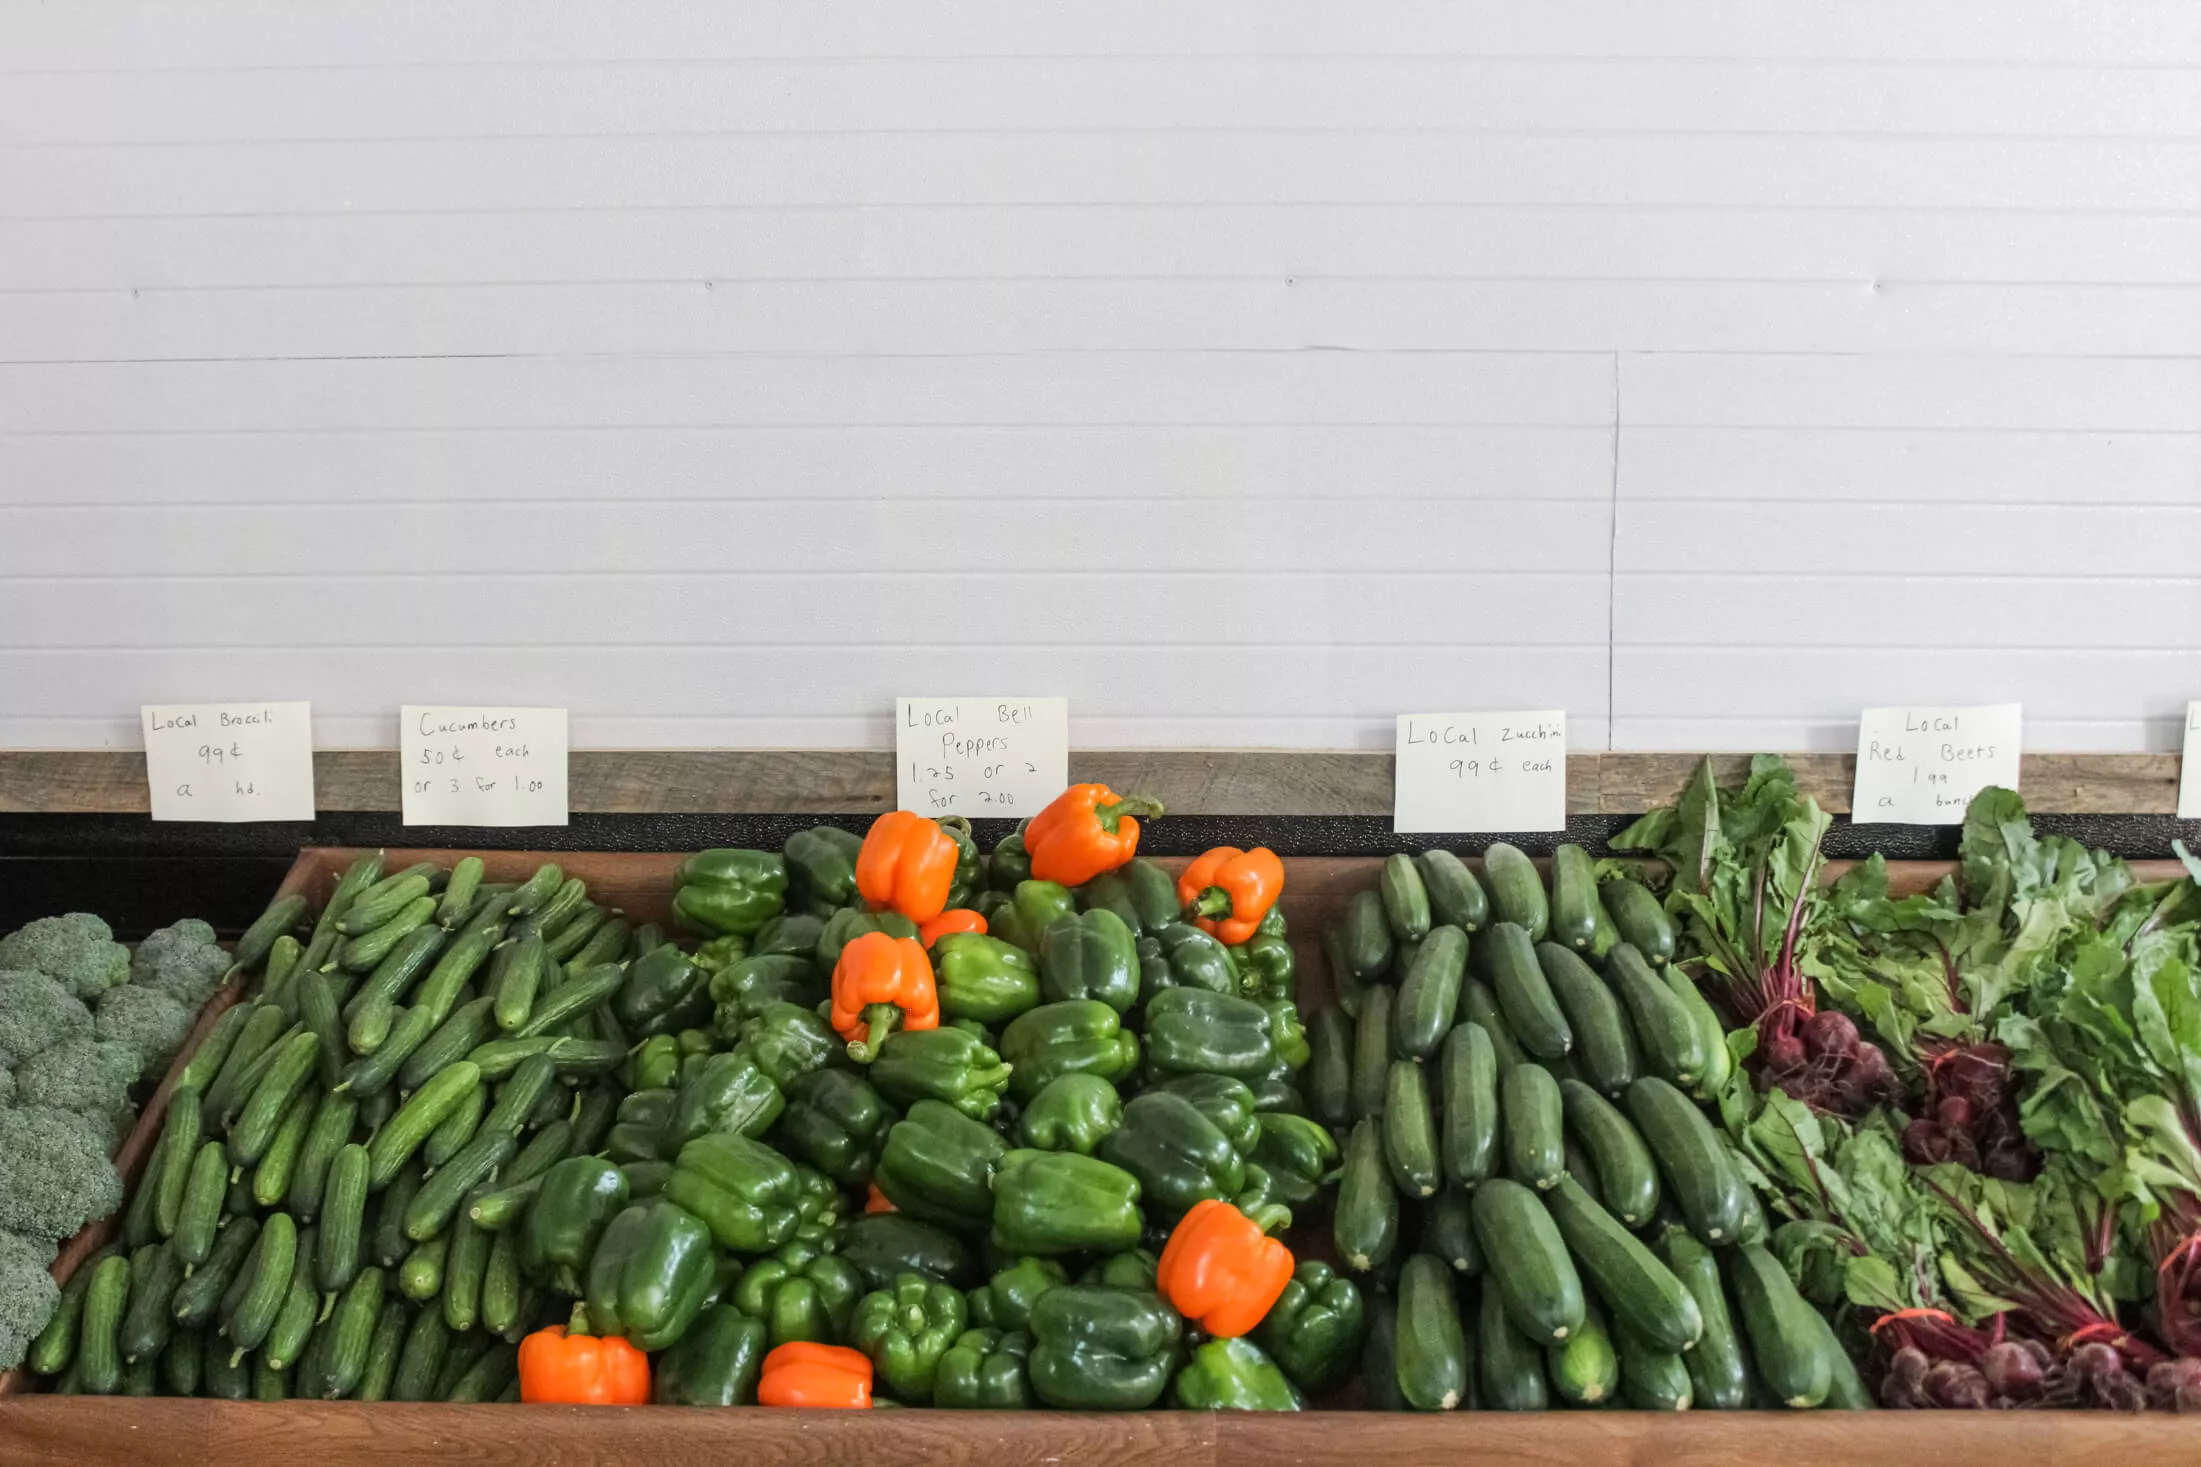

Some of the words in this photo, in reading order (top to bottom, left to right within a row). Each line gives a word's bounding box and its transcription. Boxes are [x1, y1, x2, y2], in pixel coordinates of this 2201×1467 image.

[420, 712, 517, 736] Cucumbers
[997, 704, 1032, 724] Bell
[198, 743, 243, 764] 99¢
[420, 745, 465, 765] 50¢
[495, 744, 530, 758] each
[942, 732, 1009, 759] Peppers
[1869, 741, 1906, 761] Red
[1940, 743, 1997, 762] Beets
[912, 761, 954, 783] 1.25
[984, 763, 1005, 779] or
[1024, 762, 1038, 774] 2
[1450, 756, 1503, 779] 99¢
[176, 783, 193, 797] a
[414, 780, 431, 793] or
[450, 778, 460, 793] 3
[475, 776, 497, 793] for
[928, 788, 959, 809] for
[977, 791, 1015, 806] 2.00
[1878, 796, 1896, 807] a
